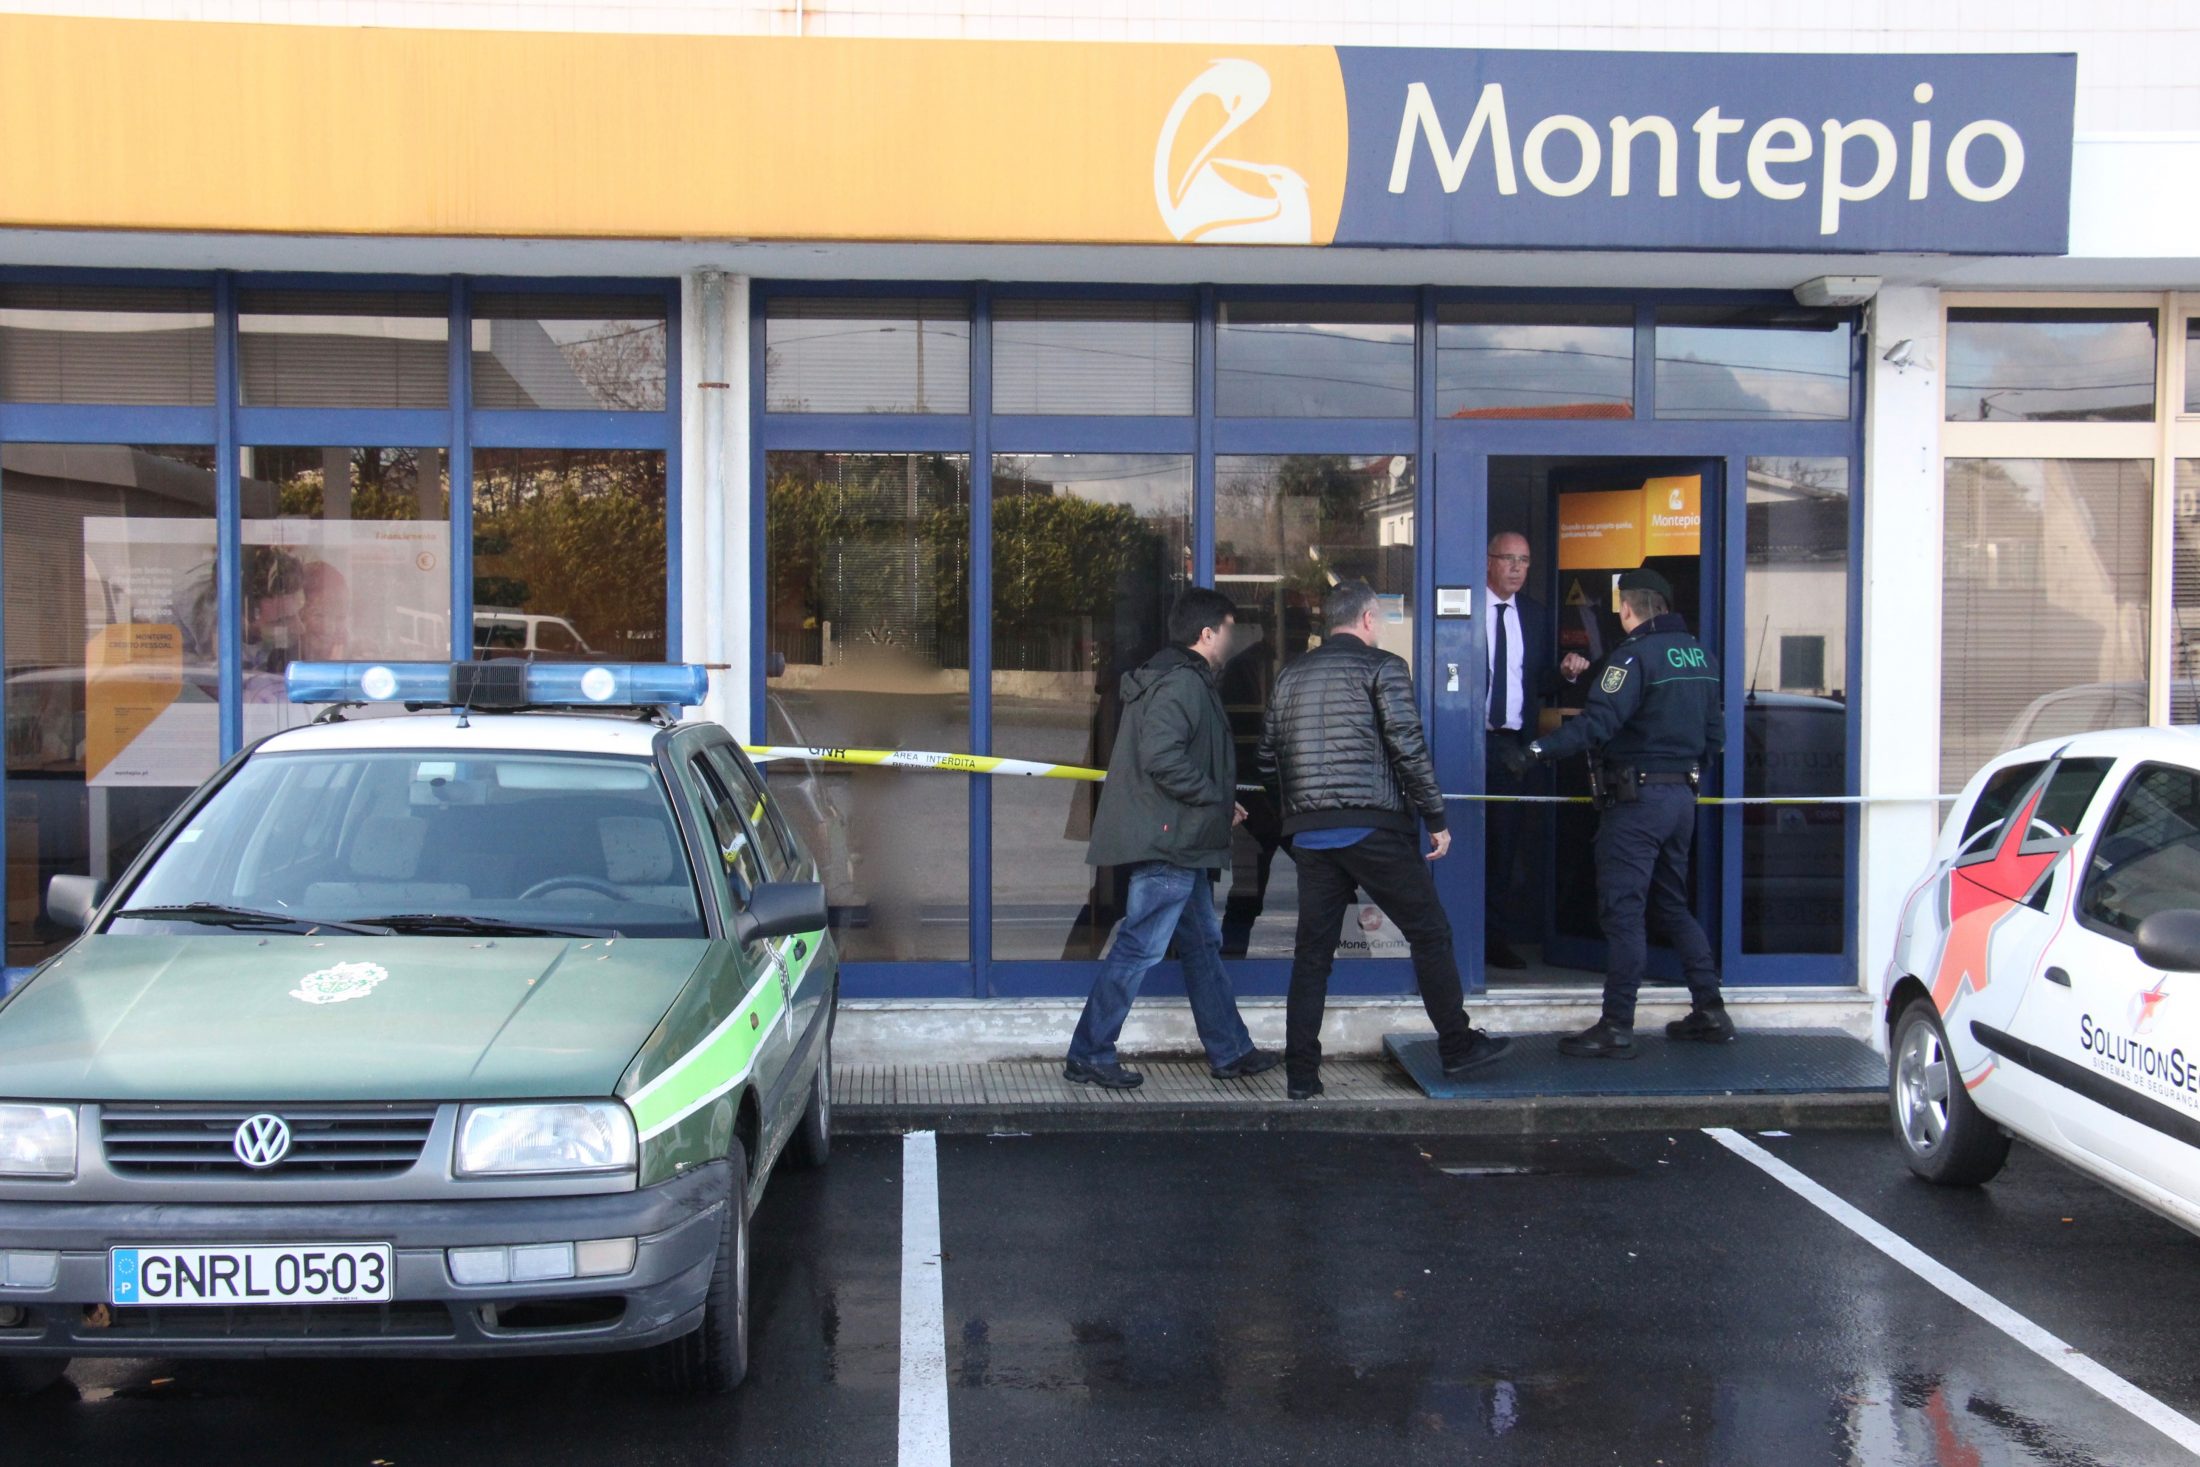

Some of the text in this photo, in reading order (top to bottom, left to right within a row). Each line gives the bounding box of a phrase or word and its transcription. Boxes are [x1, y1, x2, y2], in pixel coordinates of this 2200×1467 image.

[1388, 82, 2025, 235] Montepio
[1652, 513, 1700, 529] Montepio
[1667, 648, 1708, 668] GNR
[926, 755, 976, 769] INTERDITA
[2093, 1057, 2130, 1082] SISTEMAS
[2134, 1073, 2144, 1087] DE
[121, 1282, 132, 1295] P
